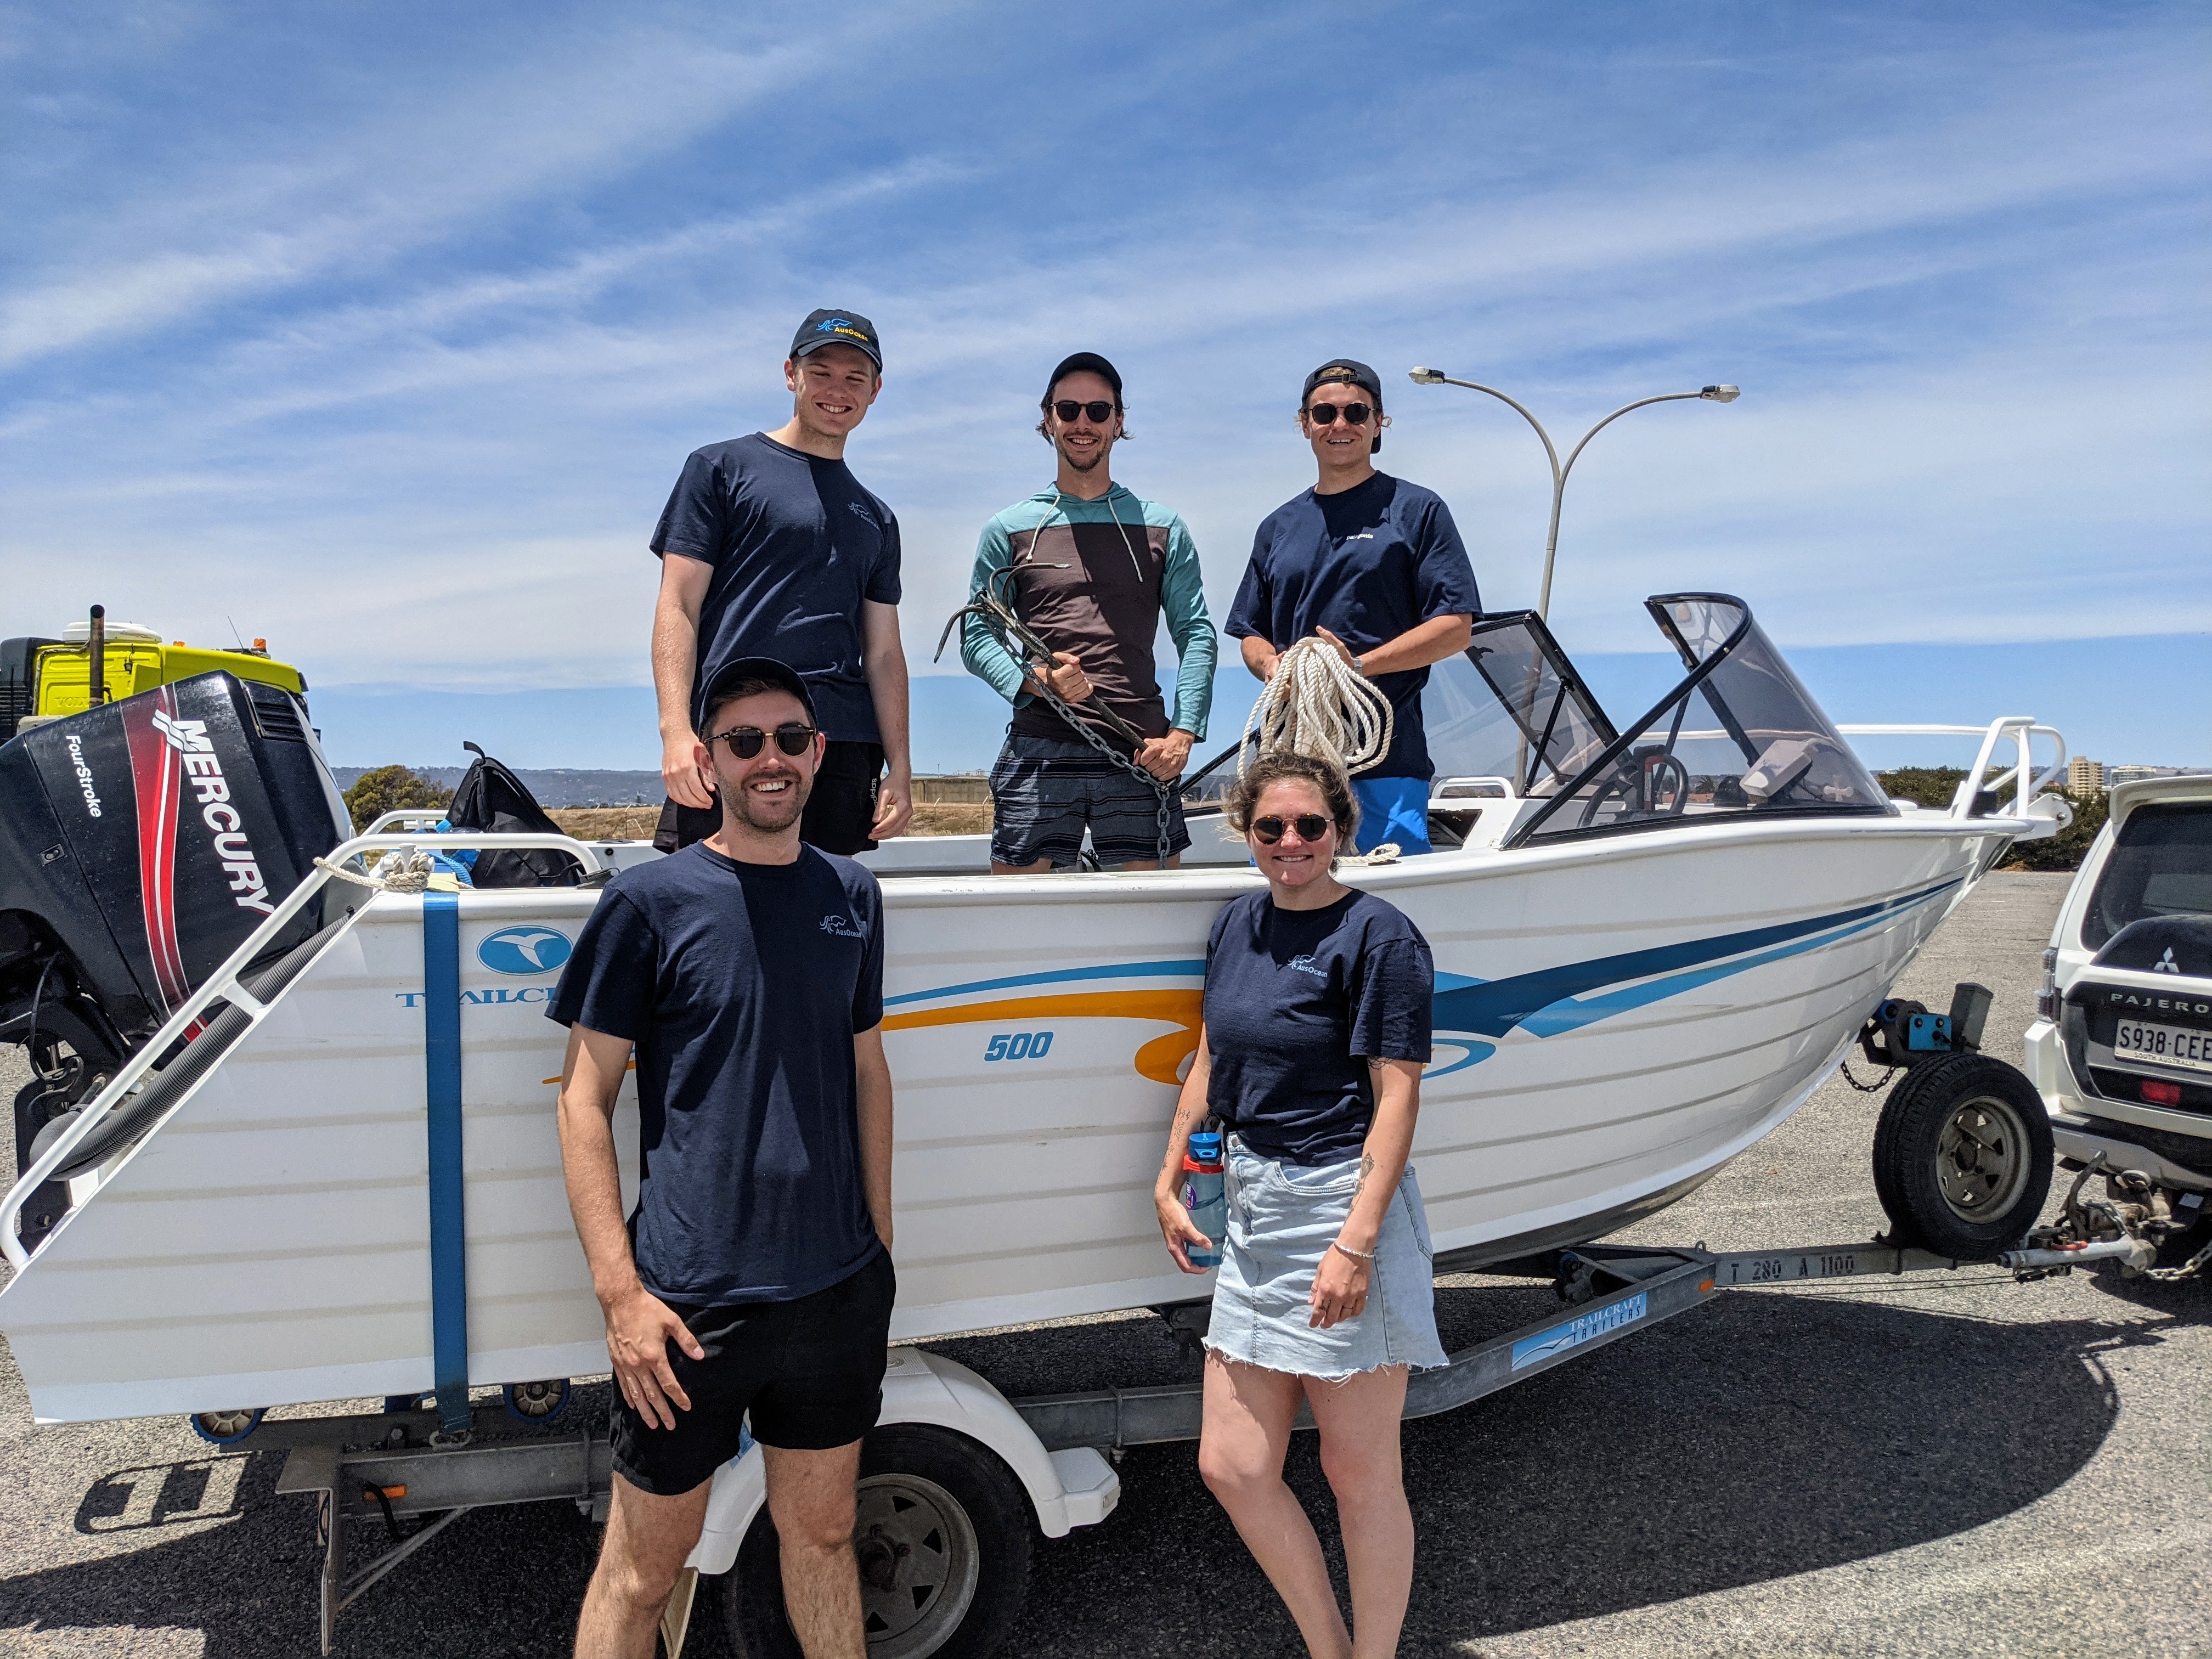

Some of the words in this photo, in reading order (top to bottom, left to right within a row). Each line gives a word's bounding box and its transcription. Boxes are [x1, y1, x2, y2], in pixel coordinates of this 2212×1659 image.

[834, 327, 868, 342] AusOcean
[65, 735, 101, 817] FourStroke
[171, 720, 275, 914] MERCURY
[1296, 964, 1328, 978] AusOcean
[395, 988, 557, 1008] TAILC
[2111, 993, 2209, 1013] PAJERO
[984, 1031, 1054, 1062] 500
[2134, 1051, 2157, 1061] SOUTH
[2158, 1056, 2197, 1068] AUSTRALIA
[1731, 1263, 1739, 1283] T
[1752, 1259, 1782, 1280] 280
[1798, 1257, 1809, 1277] A
[1821, 1255, 1854, 1276] 1100
[1569, 1294, 1643, 1332] TRAILCRAFT
[1572, 1305, 1640, 1344] TRAILERS
